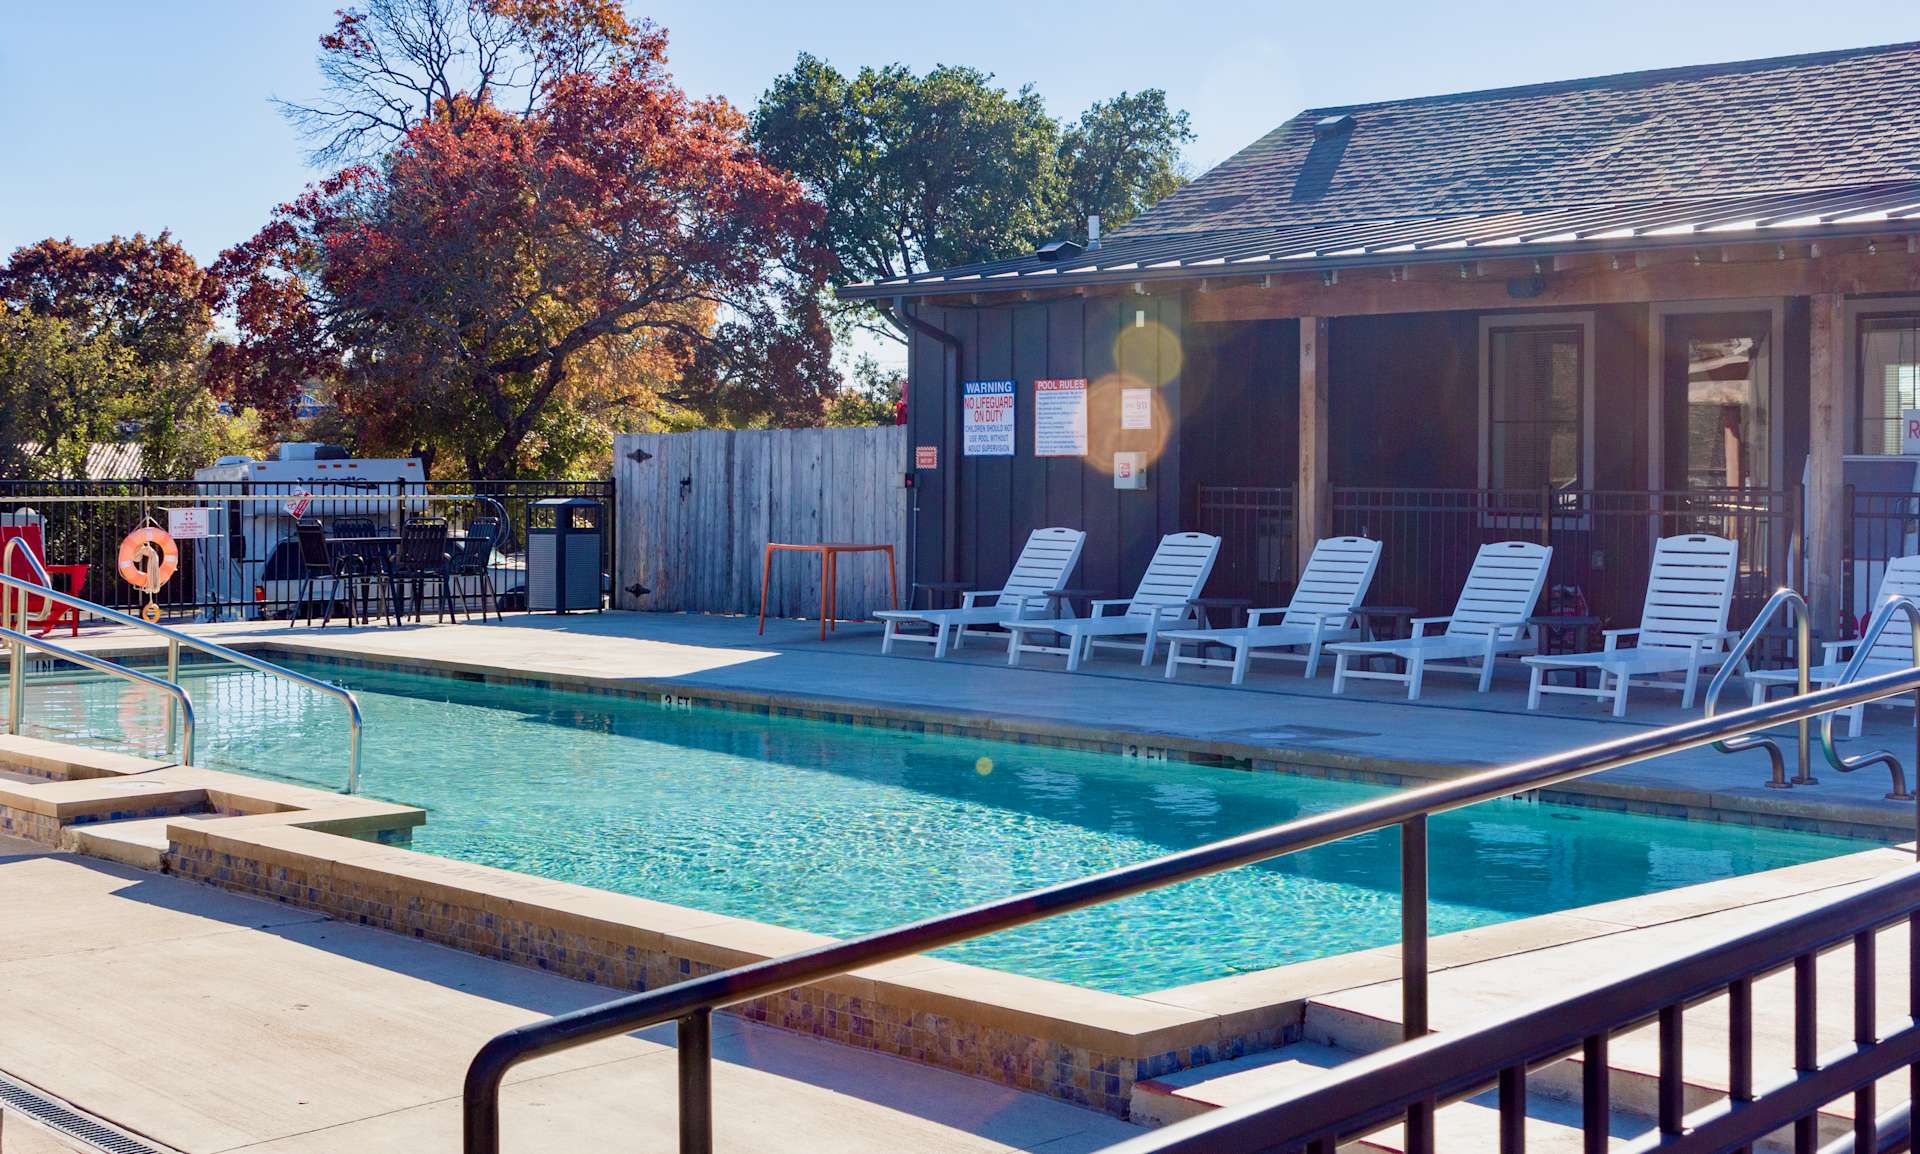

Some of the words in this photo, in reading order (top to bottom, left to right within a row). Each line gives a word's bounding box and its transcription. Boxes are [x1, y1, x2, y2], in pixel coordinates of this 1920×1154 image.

[966, 381, 1012, 393] WARNING
[1037, 381, 1057, 390] POOL
[1059, 379, 1085, 389] RULES
[964, 397, 975, 409] NO
[976, 396, 1013, 409] LIFEGUARD
[974, 410, 984, 423] ON
[985, 409, 1004, 422] DUTY
[1908, 420, 1920, 439] R
[1129, 744, 1138, 758] 3
[1146, 746, 1166, 761] FT
